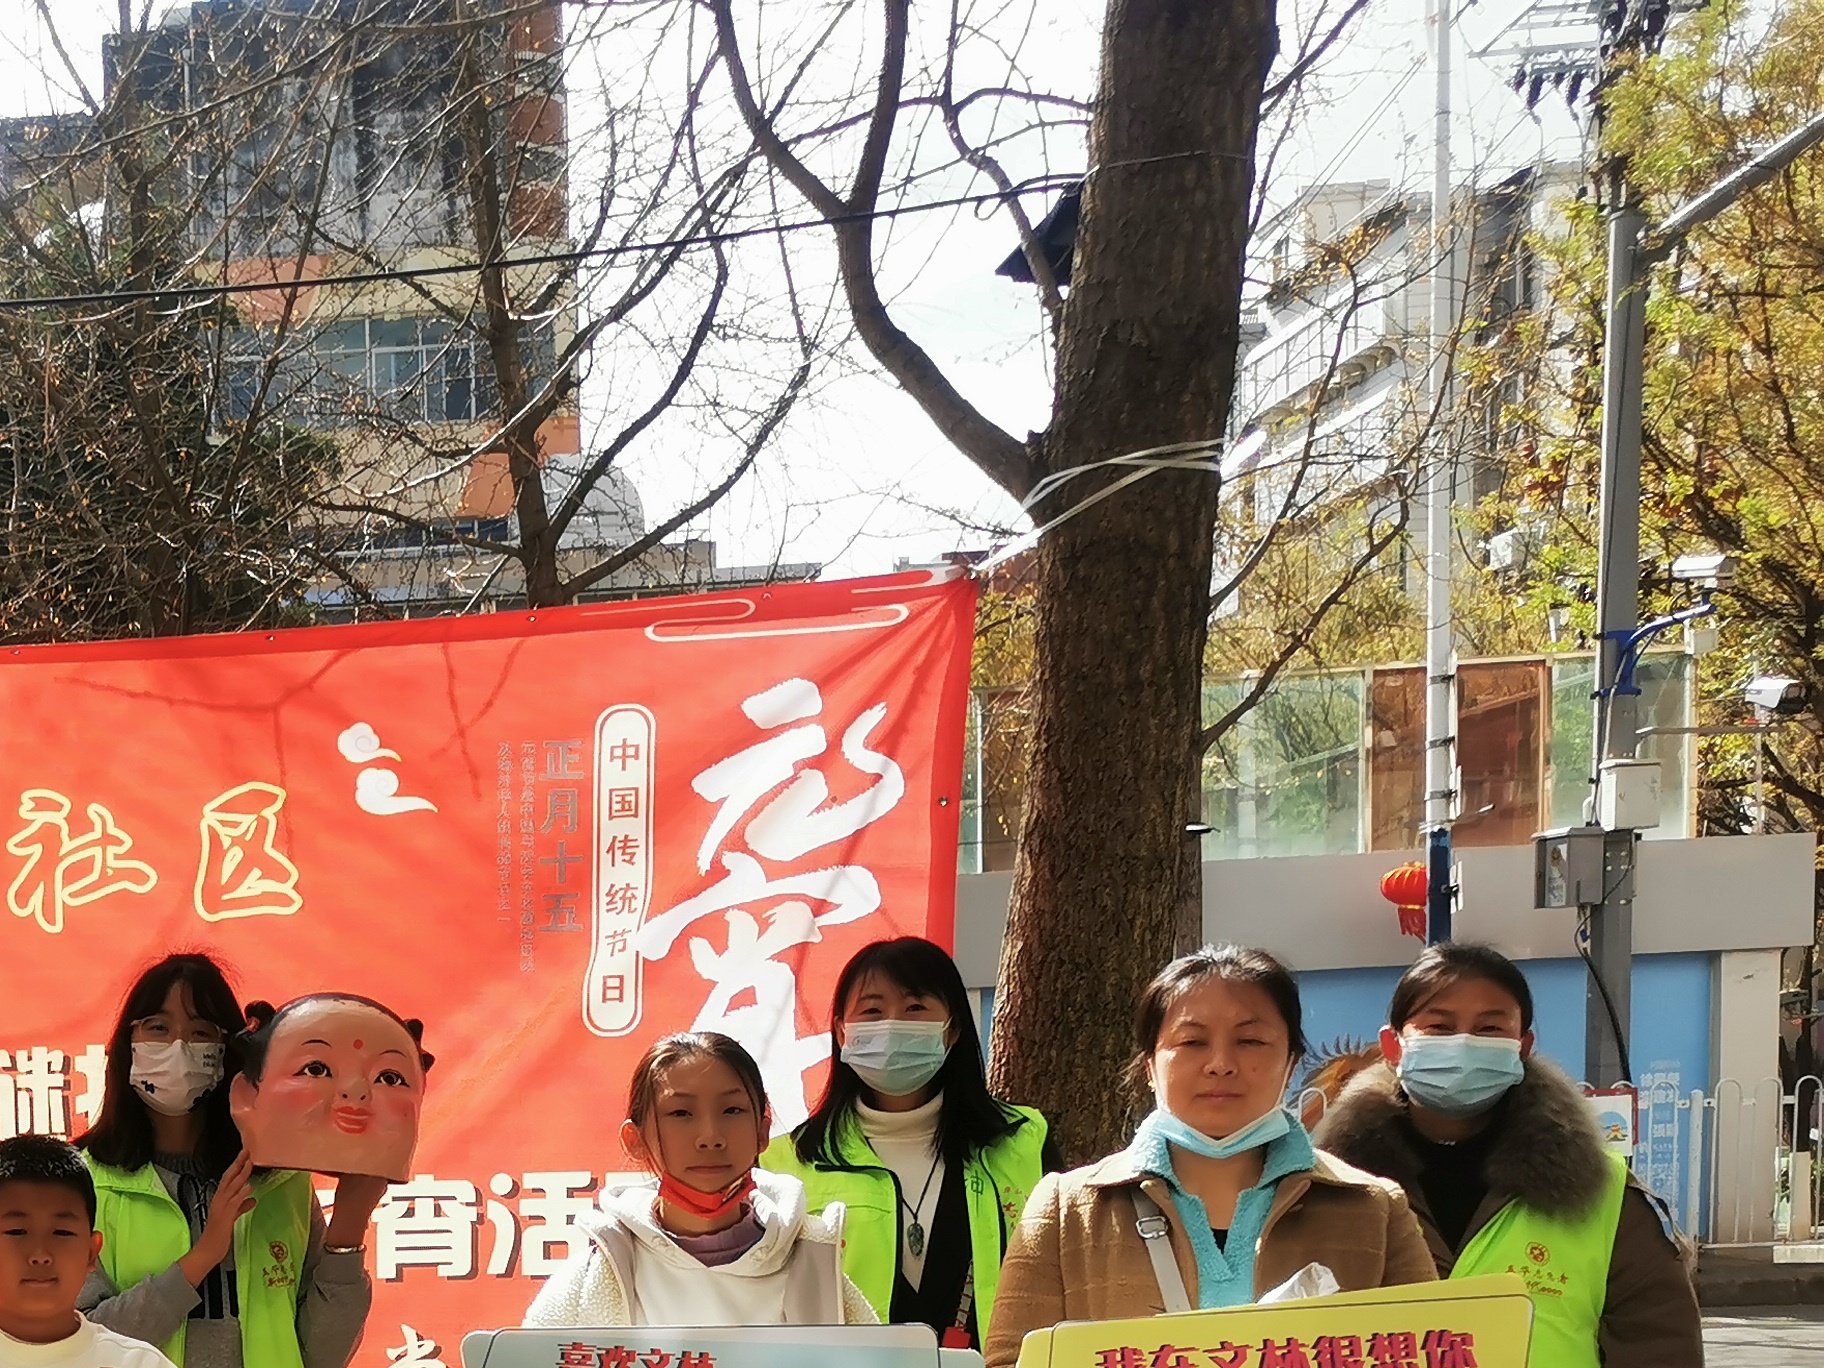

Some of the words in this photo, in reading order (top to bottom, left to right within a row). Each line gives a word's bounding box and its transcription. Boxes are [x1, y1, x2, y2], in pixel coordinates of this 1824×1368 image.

[539, 739, 584, 932] 正月十五
[601, 737, 641, 1005] 中国传统节日
